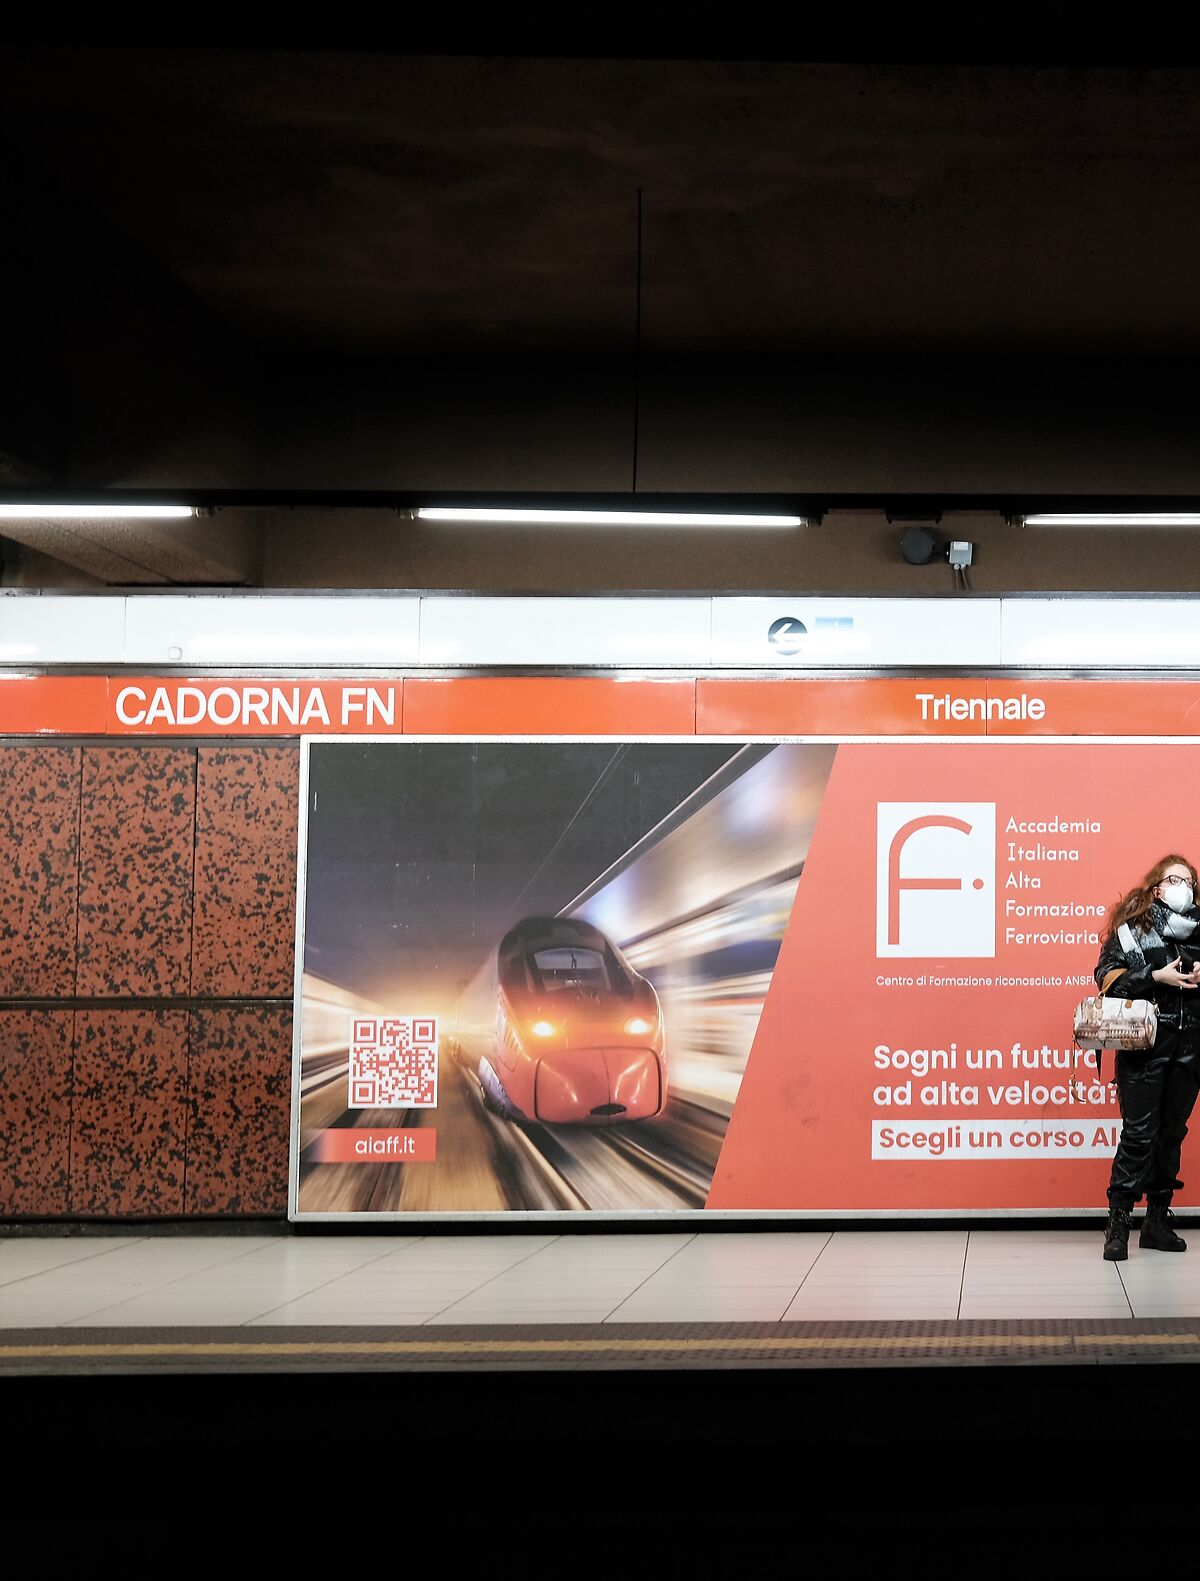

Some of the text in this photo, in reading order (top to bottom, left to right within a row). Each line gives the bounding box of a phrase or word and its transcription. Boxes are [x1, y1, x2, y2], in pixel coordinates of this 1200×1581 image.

[115, 686, 395, 726] CADORNA FN
[915, 693, 1046, 720] Triennale
[1005, 816, 1101, 833] Accademia
[1007, 843, 1079, 861] Italiana
[1005, 871, 1041, 889] Alta
[1005, 900, 1106, 917] Formazione
[1005, 928, 1099, 944] Ferroviaria
[876, 975, 914, 986] Centro
[916, 975, 927, 986] di
[929, 975, 992, 987] Formazione
[995, 975, 1062, 986] riconosciuto
[874, 1043, 1098, 1077] Sogni un futuro
[873, 1080, 912, 1105] ad
[920, 1080, 979, 1105] alta
[355, 1135, 415, 1154] aiaff.it
[879, 1126, 961, 1155] Scegli
[968, 1131, 1003, 1147] un
[1009, 1131, 1085, 1147] corso
